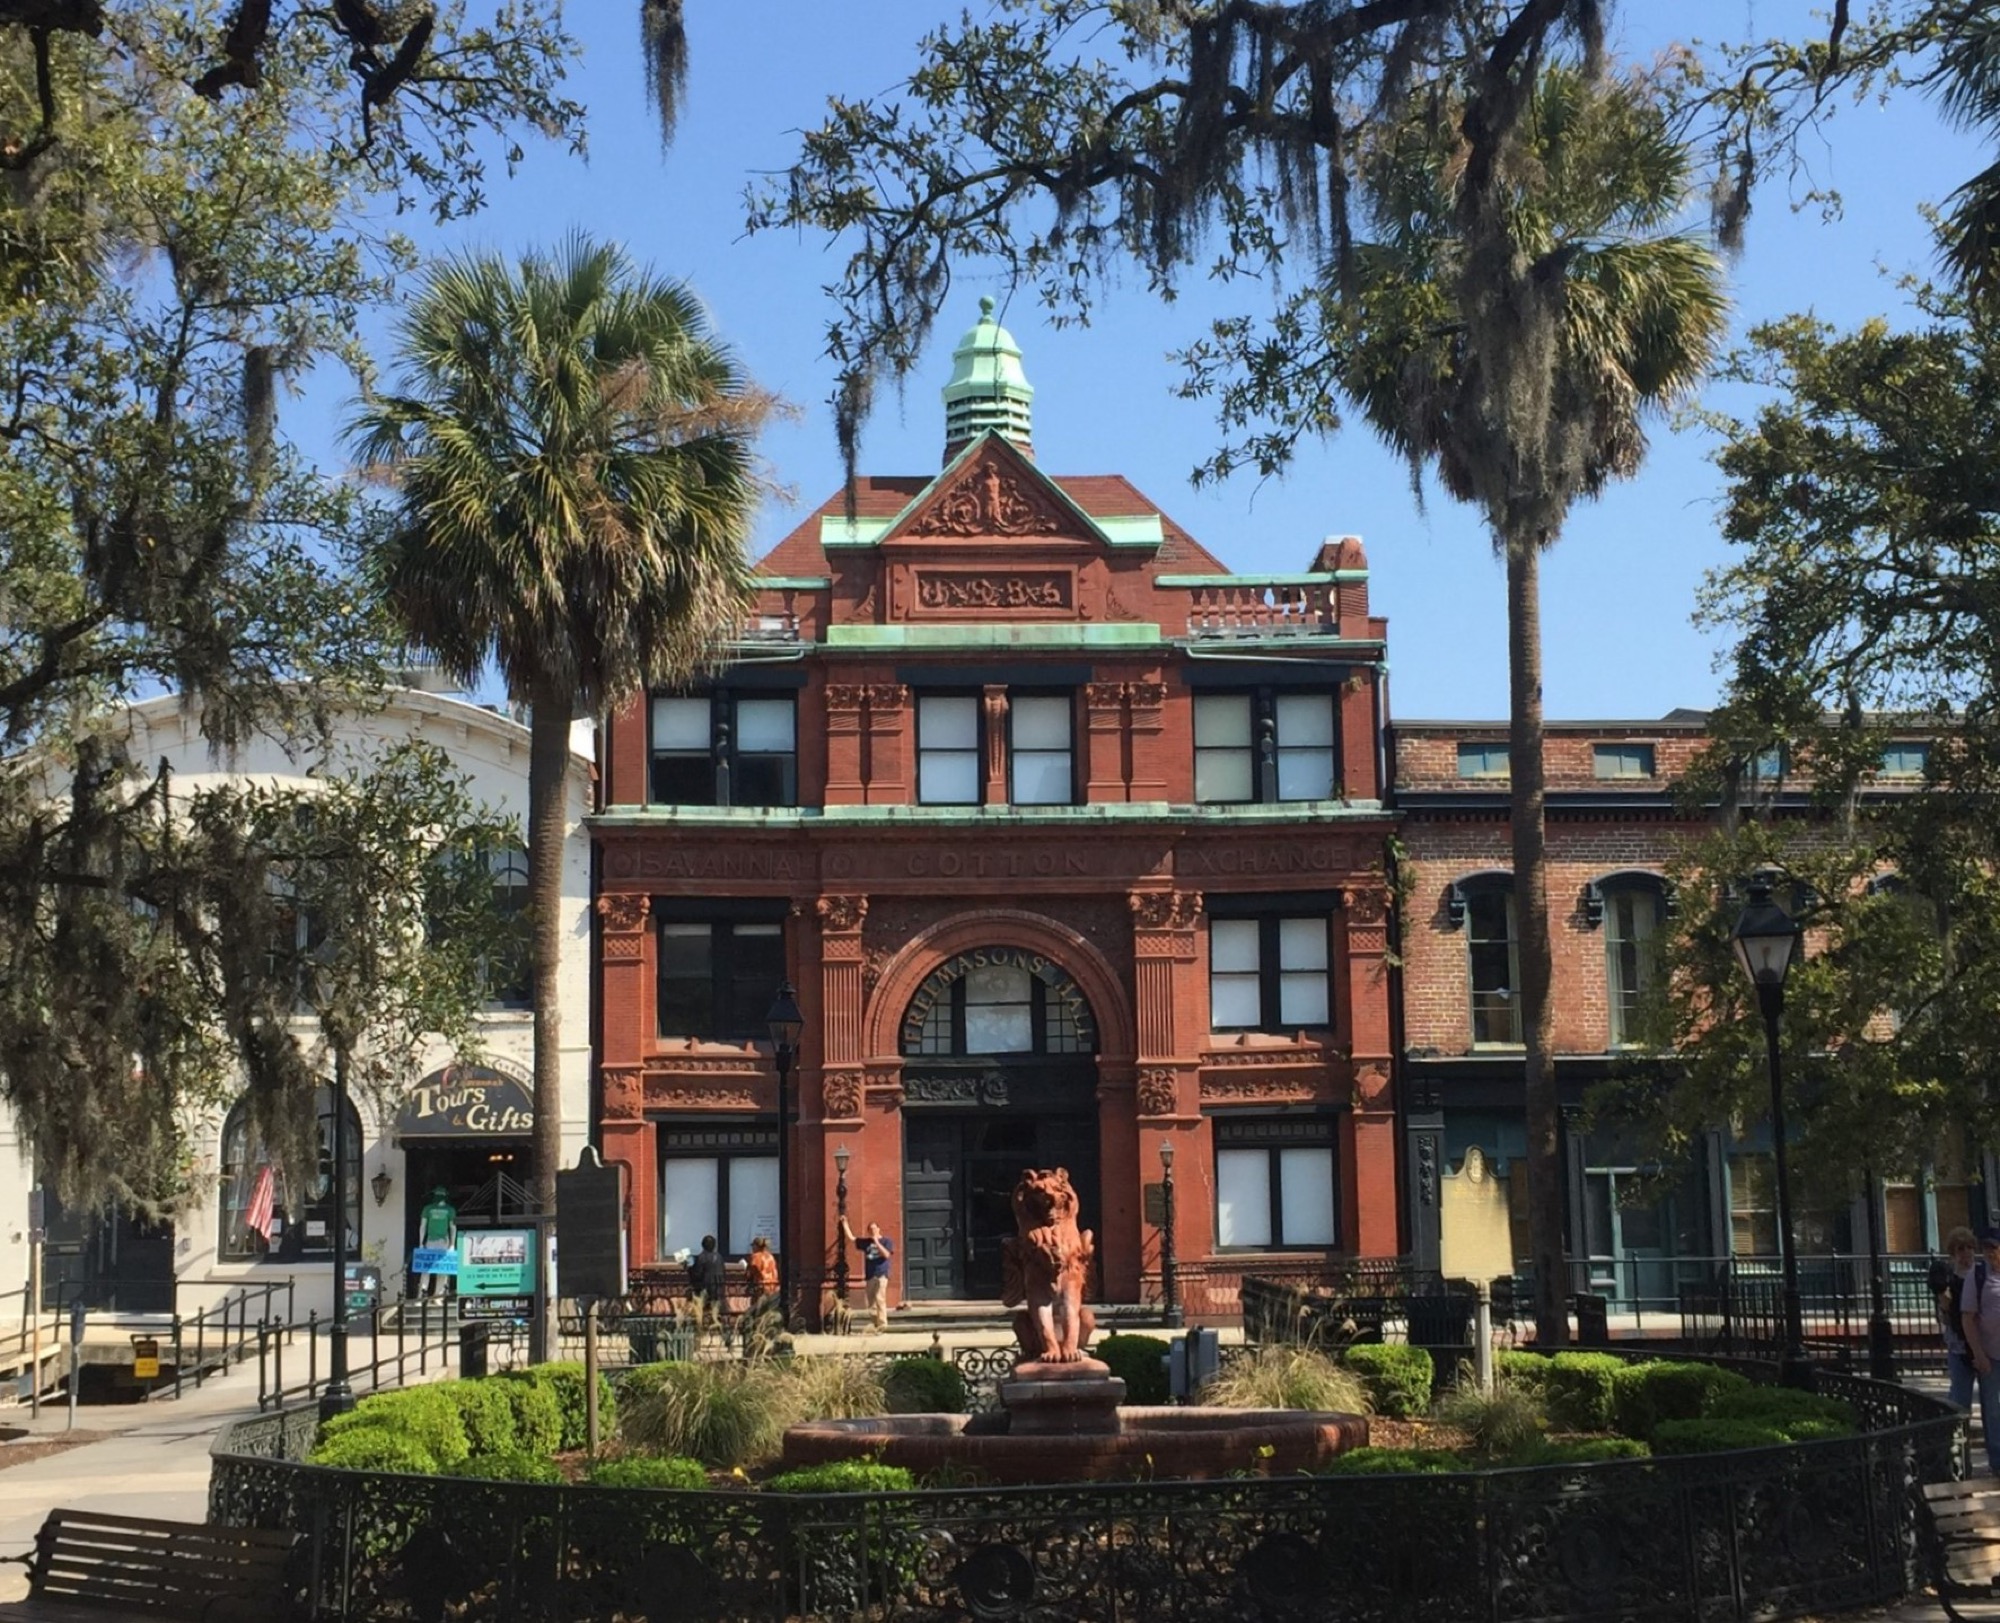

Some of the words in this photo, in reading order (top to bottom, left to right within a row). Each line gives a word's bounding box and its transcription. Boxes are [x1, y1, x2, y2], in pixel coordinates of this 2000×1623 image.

[641, 850, 816, 878] SAVANNAH
[907, 851, 1088, 876] COTTON
[1176, 847, 1350, 875] EXCHANGE
[412, 1084, 486, 1118] Tours
[466, 1104, 534, 1131] Gifts
